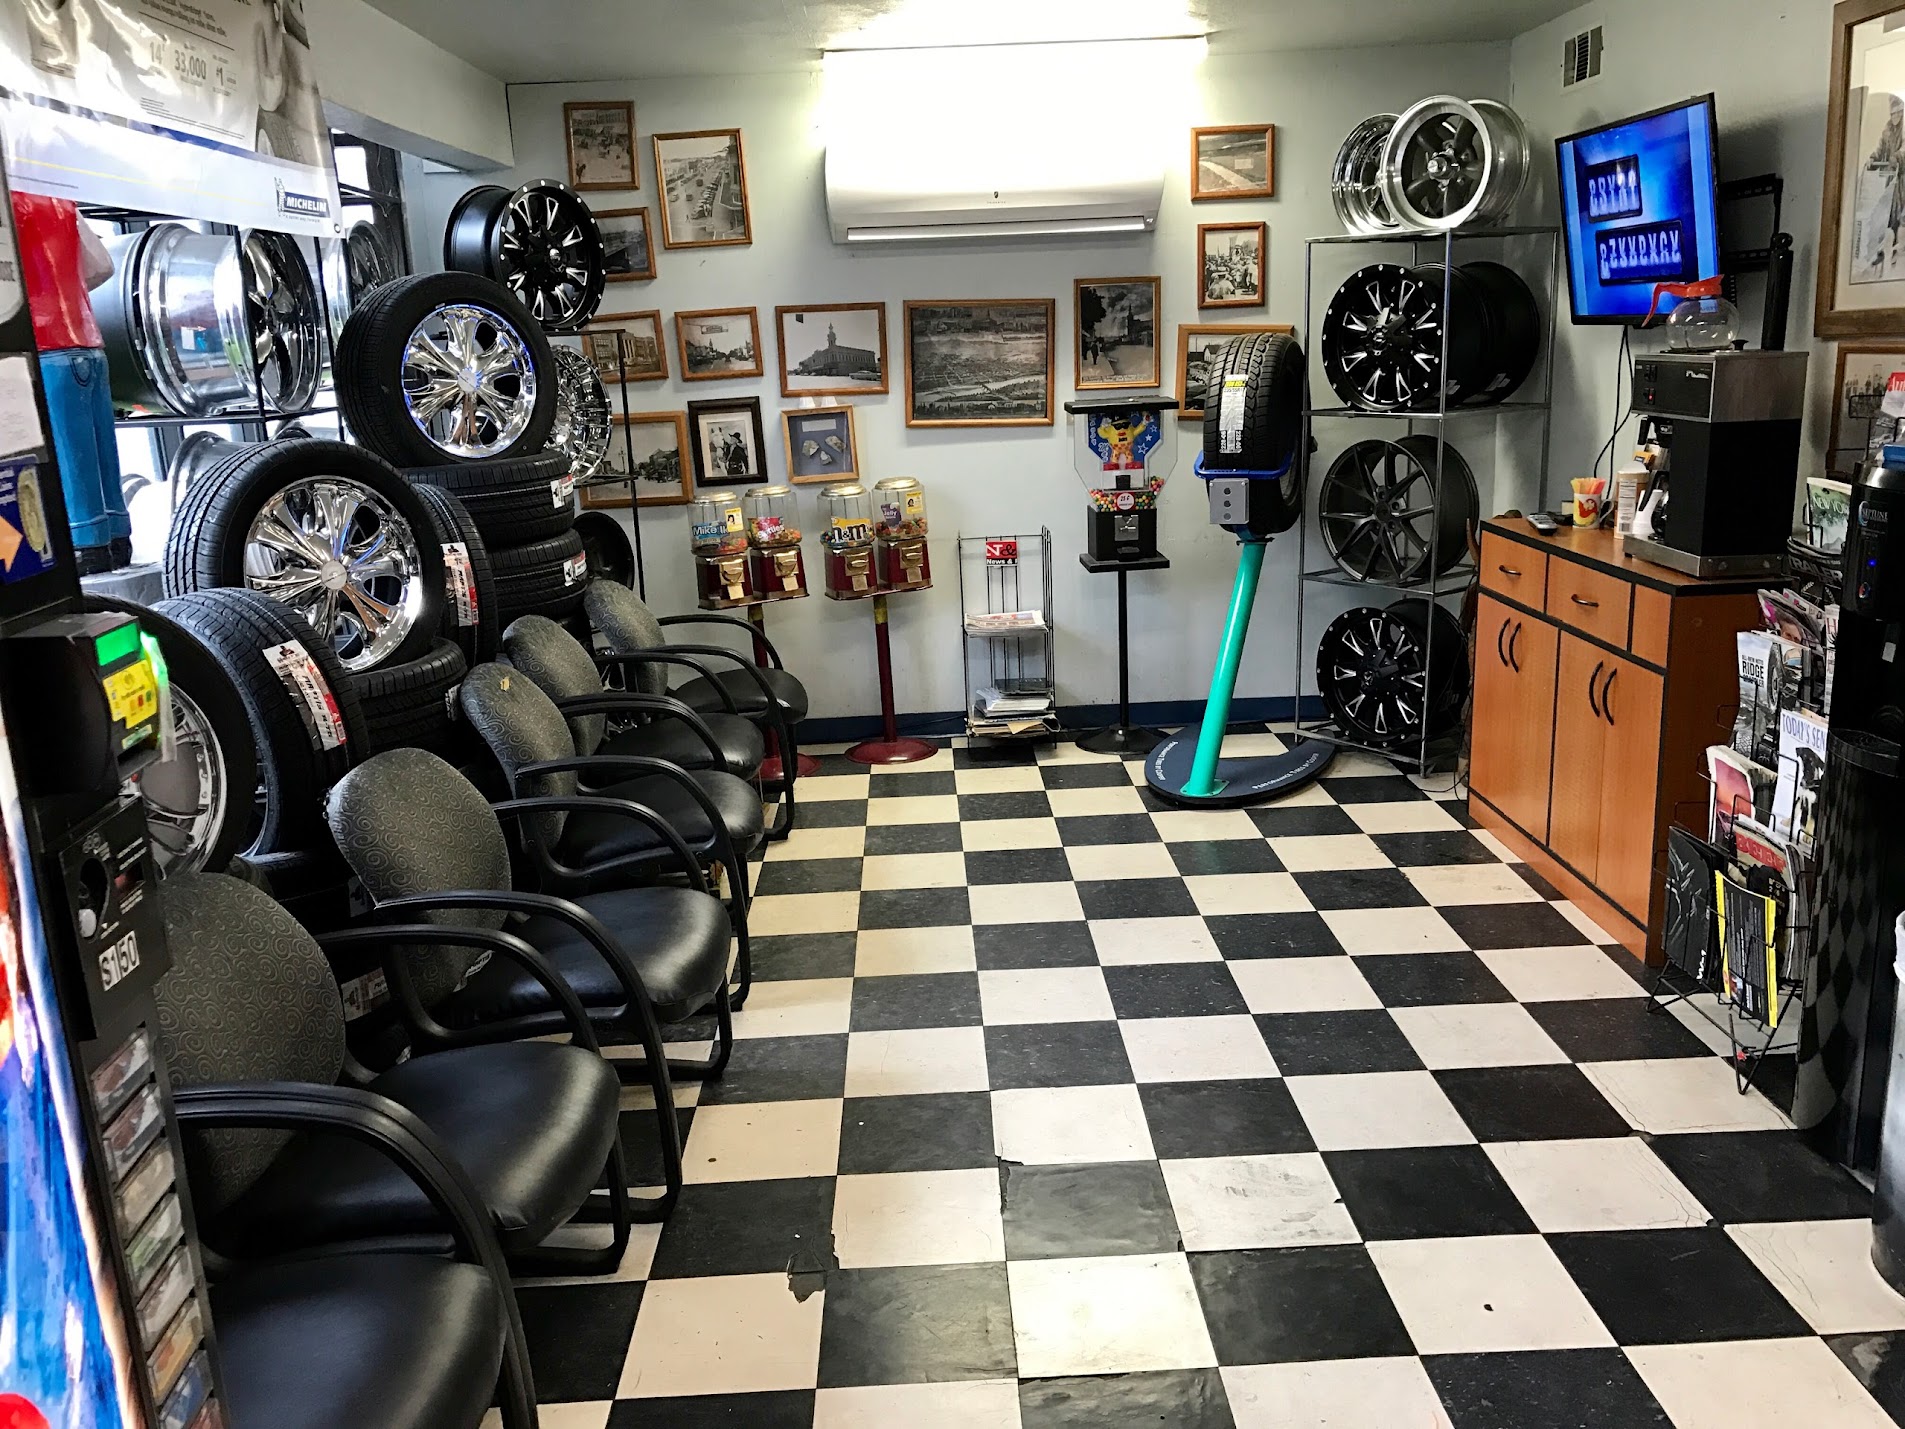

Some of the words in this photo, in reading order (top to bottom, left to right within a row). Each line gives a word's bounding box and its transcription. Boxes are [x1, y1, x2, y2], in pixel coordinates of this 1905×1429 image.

[174, 49, 207, 80] 33,000
[286, 196, 327, 213] MICHELIN
[1812, 494, 1831, 510] NEW
[1862, 507, 1888, 520] NEPTUNE
[693, 525, 717, 536] Mike
[1788, 554, 1843, 583] TRAILER
[1742, 660, 1764, 680] RIDGE
[1781, 713, 1811, 744] TODAY'S
